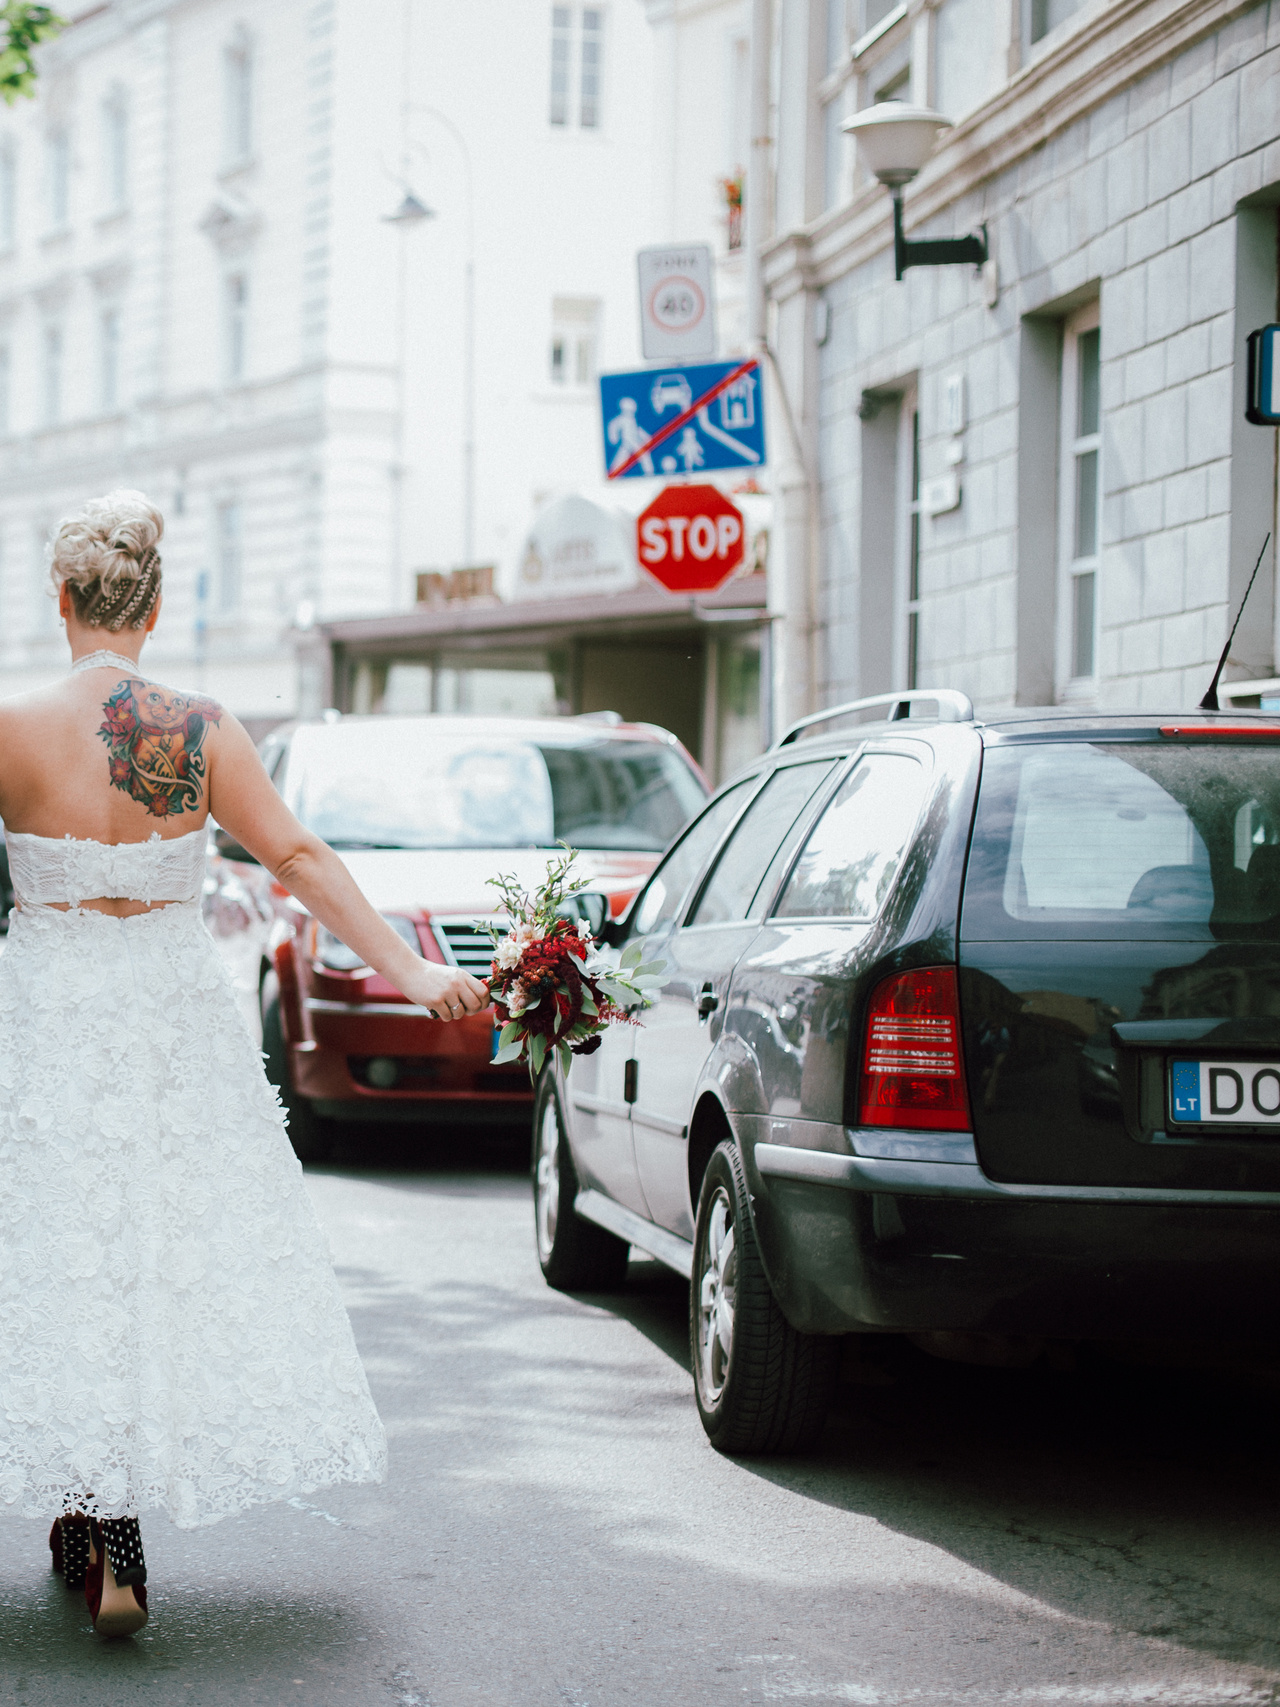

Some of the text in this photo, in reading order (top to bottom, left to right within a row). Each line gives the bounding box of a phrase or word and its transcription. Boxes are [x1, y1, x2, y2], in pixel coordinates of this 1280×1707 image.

[661, 292, 694, 317] 40
[640, 514, 741, 562] STOP
[1176, 1098, 1197, 1111] LT
